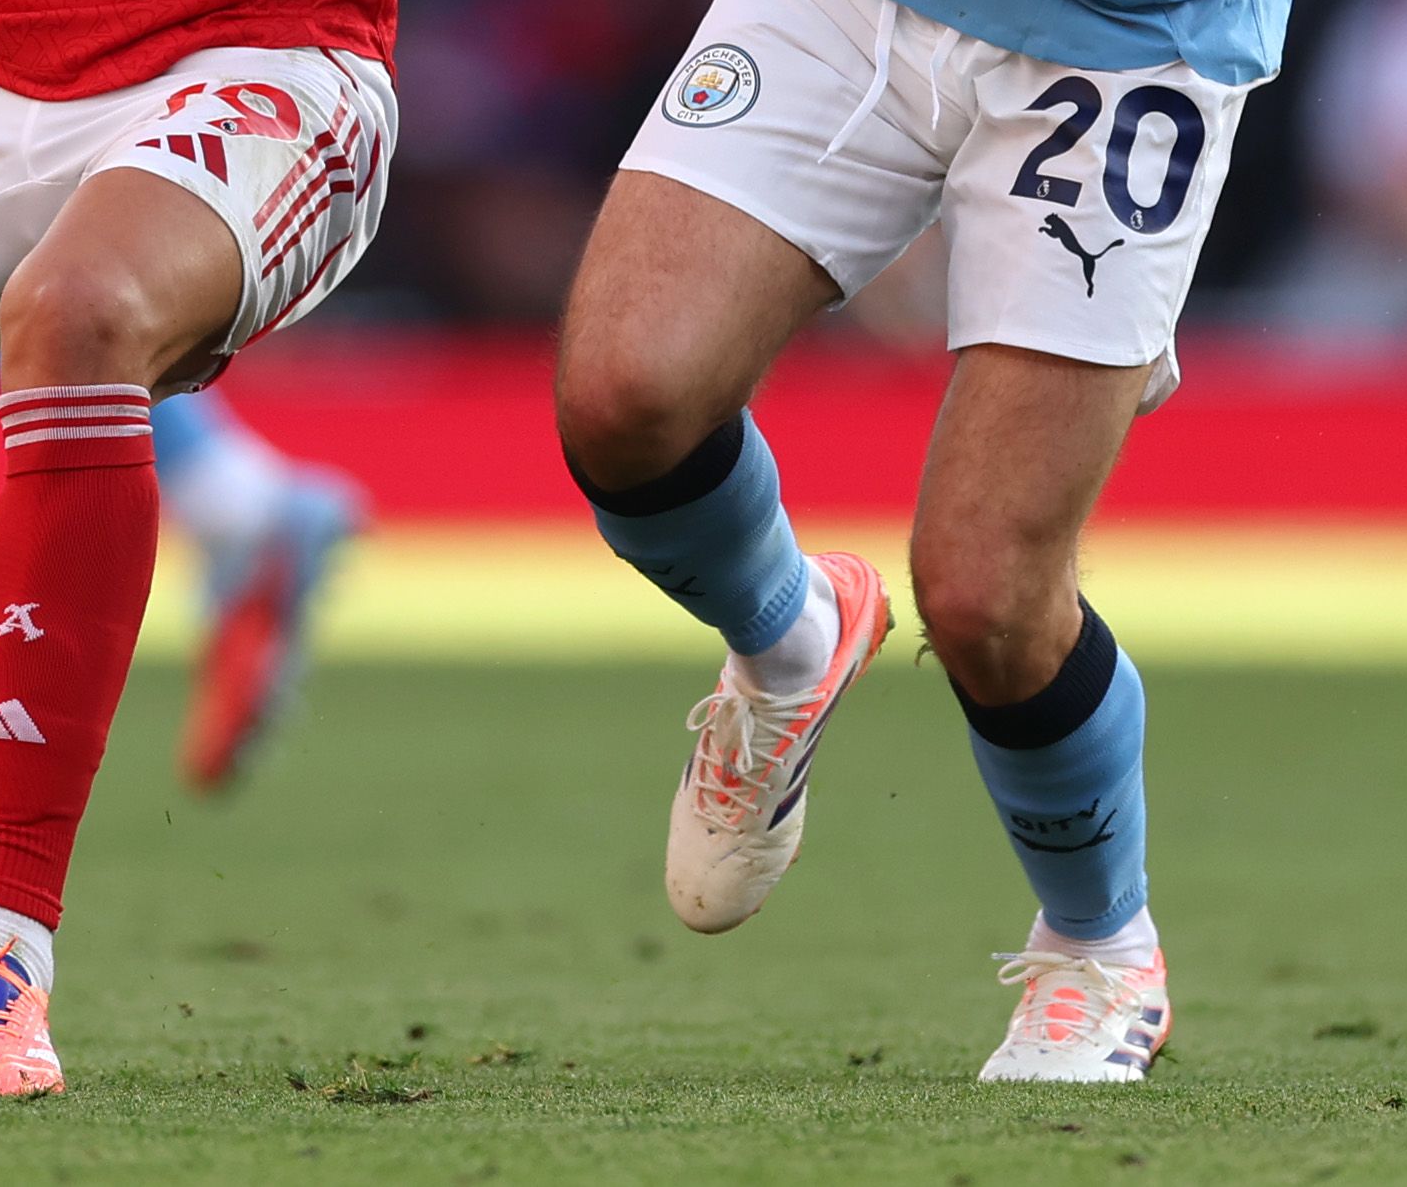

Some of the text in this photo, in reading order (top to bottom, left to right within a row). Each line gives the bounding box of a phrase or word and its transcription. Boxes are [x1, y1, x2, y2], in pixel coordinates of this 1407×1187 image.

[685, 50, 753, 88] MANCHESTER
[677, 110, 704, 122] CITY
[1010, 75, 1206, 236] 20
